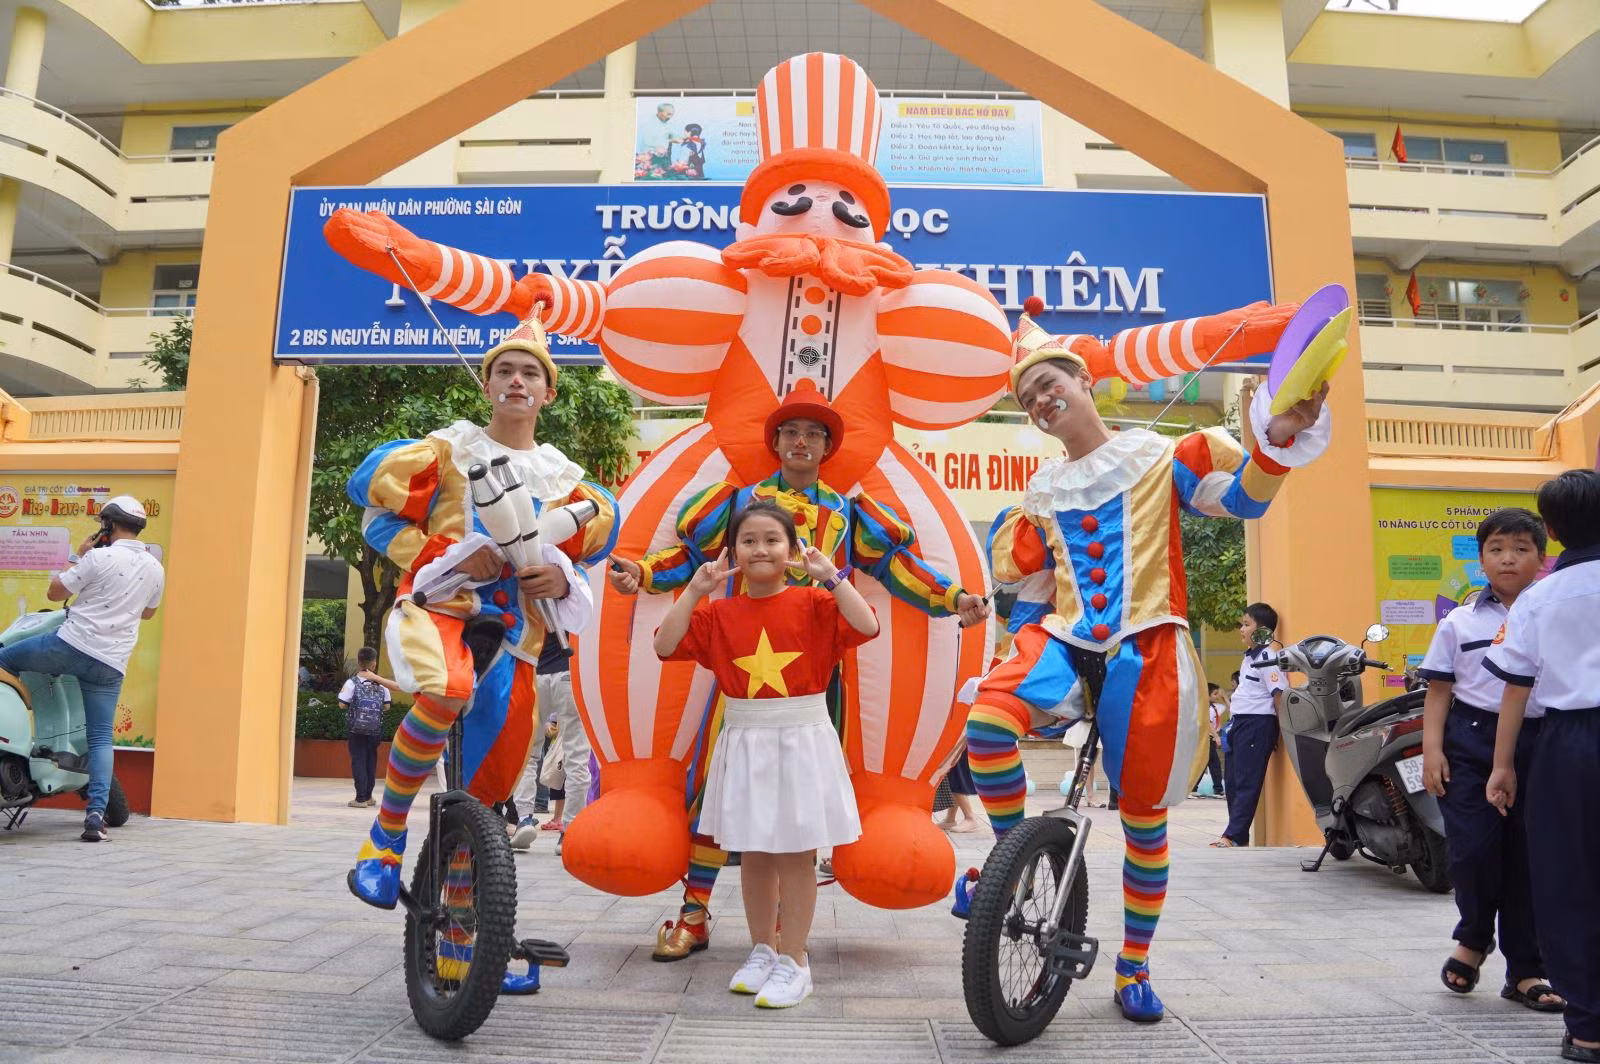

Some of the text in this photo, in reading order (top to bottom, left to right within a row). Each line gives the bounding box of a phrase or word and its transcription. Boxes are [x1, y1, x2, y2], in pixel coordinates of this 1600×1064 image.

[319, 197, 336, 217] ỦY
[398, 198, 419, 216] DÂN
[424, 196, 472, 215] PHƯỜNG
[475, 197, 494, 215] SÀI
[497, 196, 522, 215] GÒN
[885, 208, 949, 239] ỌC
[915, 250, 1166, 313] HIÊM
[289, 329, 301, 346] 2
[302, 329, 328, 346] BIS
[330, 321, 391, 346] NGUYỄN
[393, 322, 429, 346] BỈNH
[944, 453, 982, 491] GIA
[986, 448, 1039, 492] ĐÌNH
[1446, 507, 1453, 516] 5
[1378, 520, 1389, 529] 10
